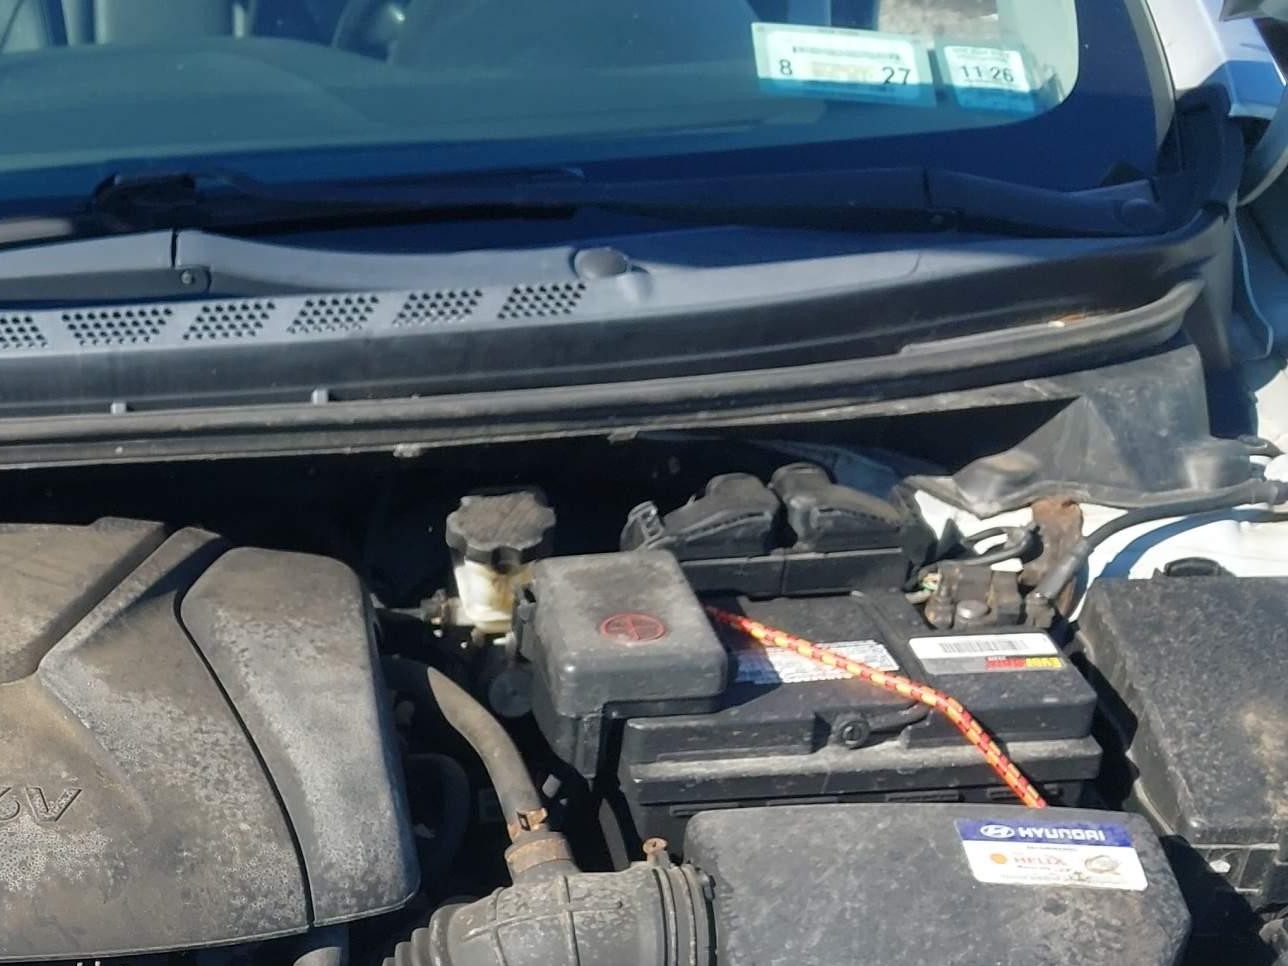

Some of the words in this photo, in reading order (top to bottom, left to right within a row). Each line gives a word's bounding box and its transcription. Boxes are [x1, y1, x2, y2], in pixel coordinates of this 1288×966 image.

[778, 58, 793, 77] 8
[881, 66, 912, 86] 27
[989, 66, 1015, 83] 26
[1018, 826, 1106, 842] HYUNDAI
